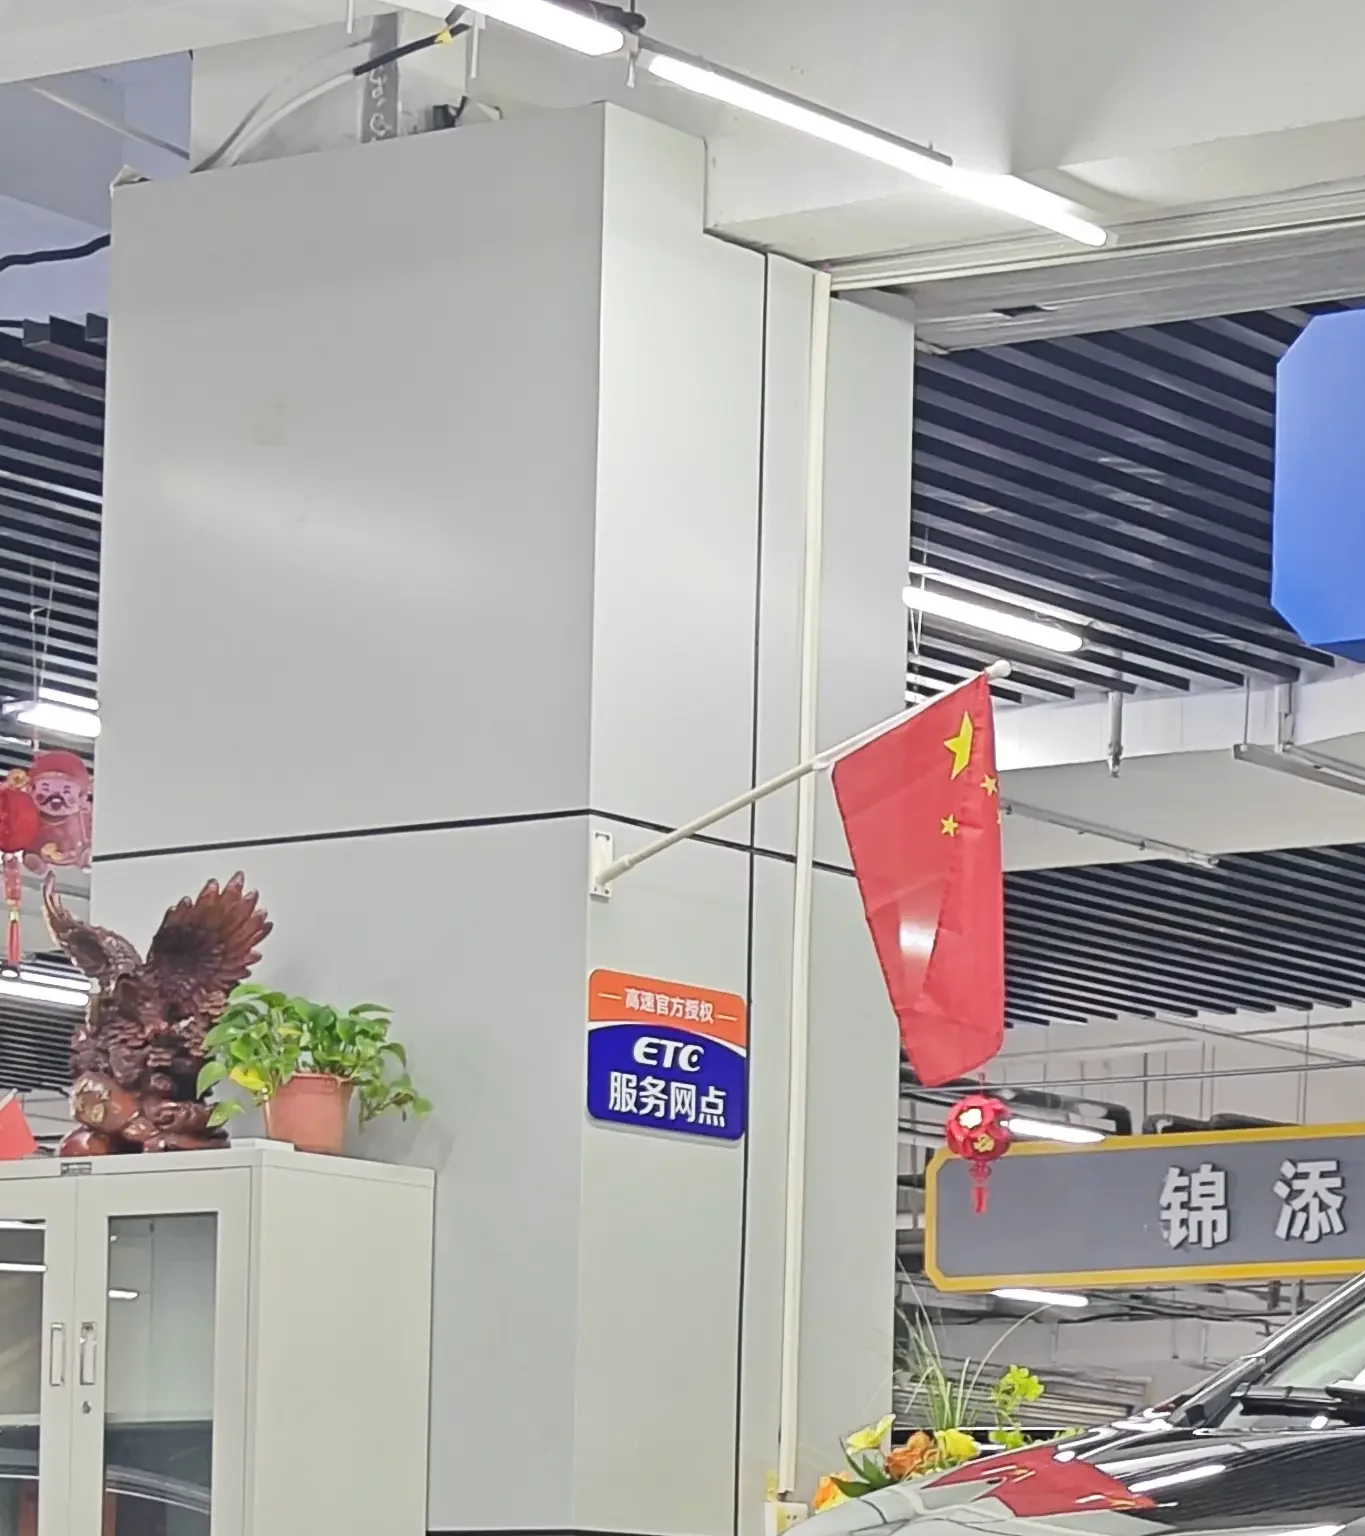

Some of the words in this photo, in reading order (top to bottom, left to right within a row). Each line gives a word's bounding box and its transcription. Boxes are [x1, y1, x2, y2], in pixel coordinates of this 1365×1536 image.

[624, 987, 715, 1024] 高速官方授权
[632, 1036, 705, 1073] ETC
[608, 1071, 726, 1127] 服务网点
